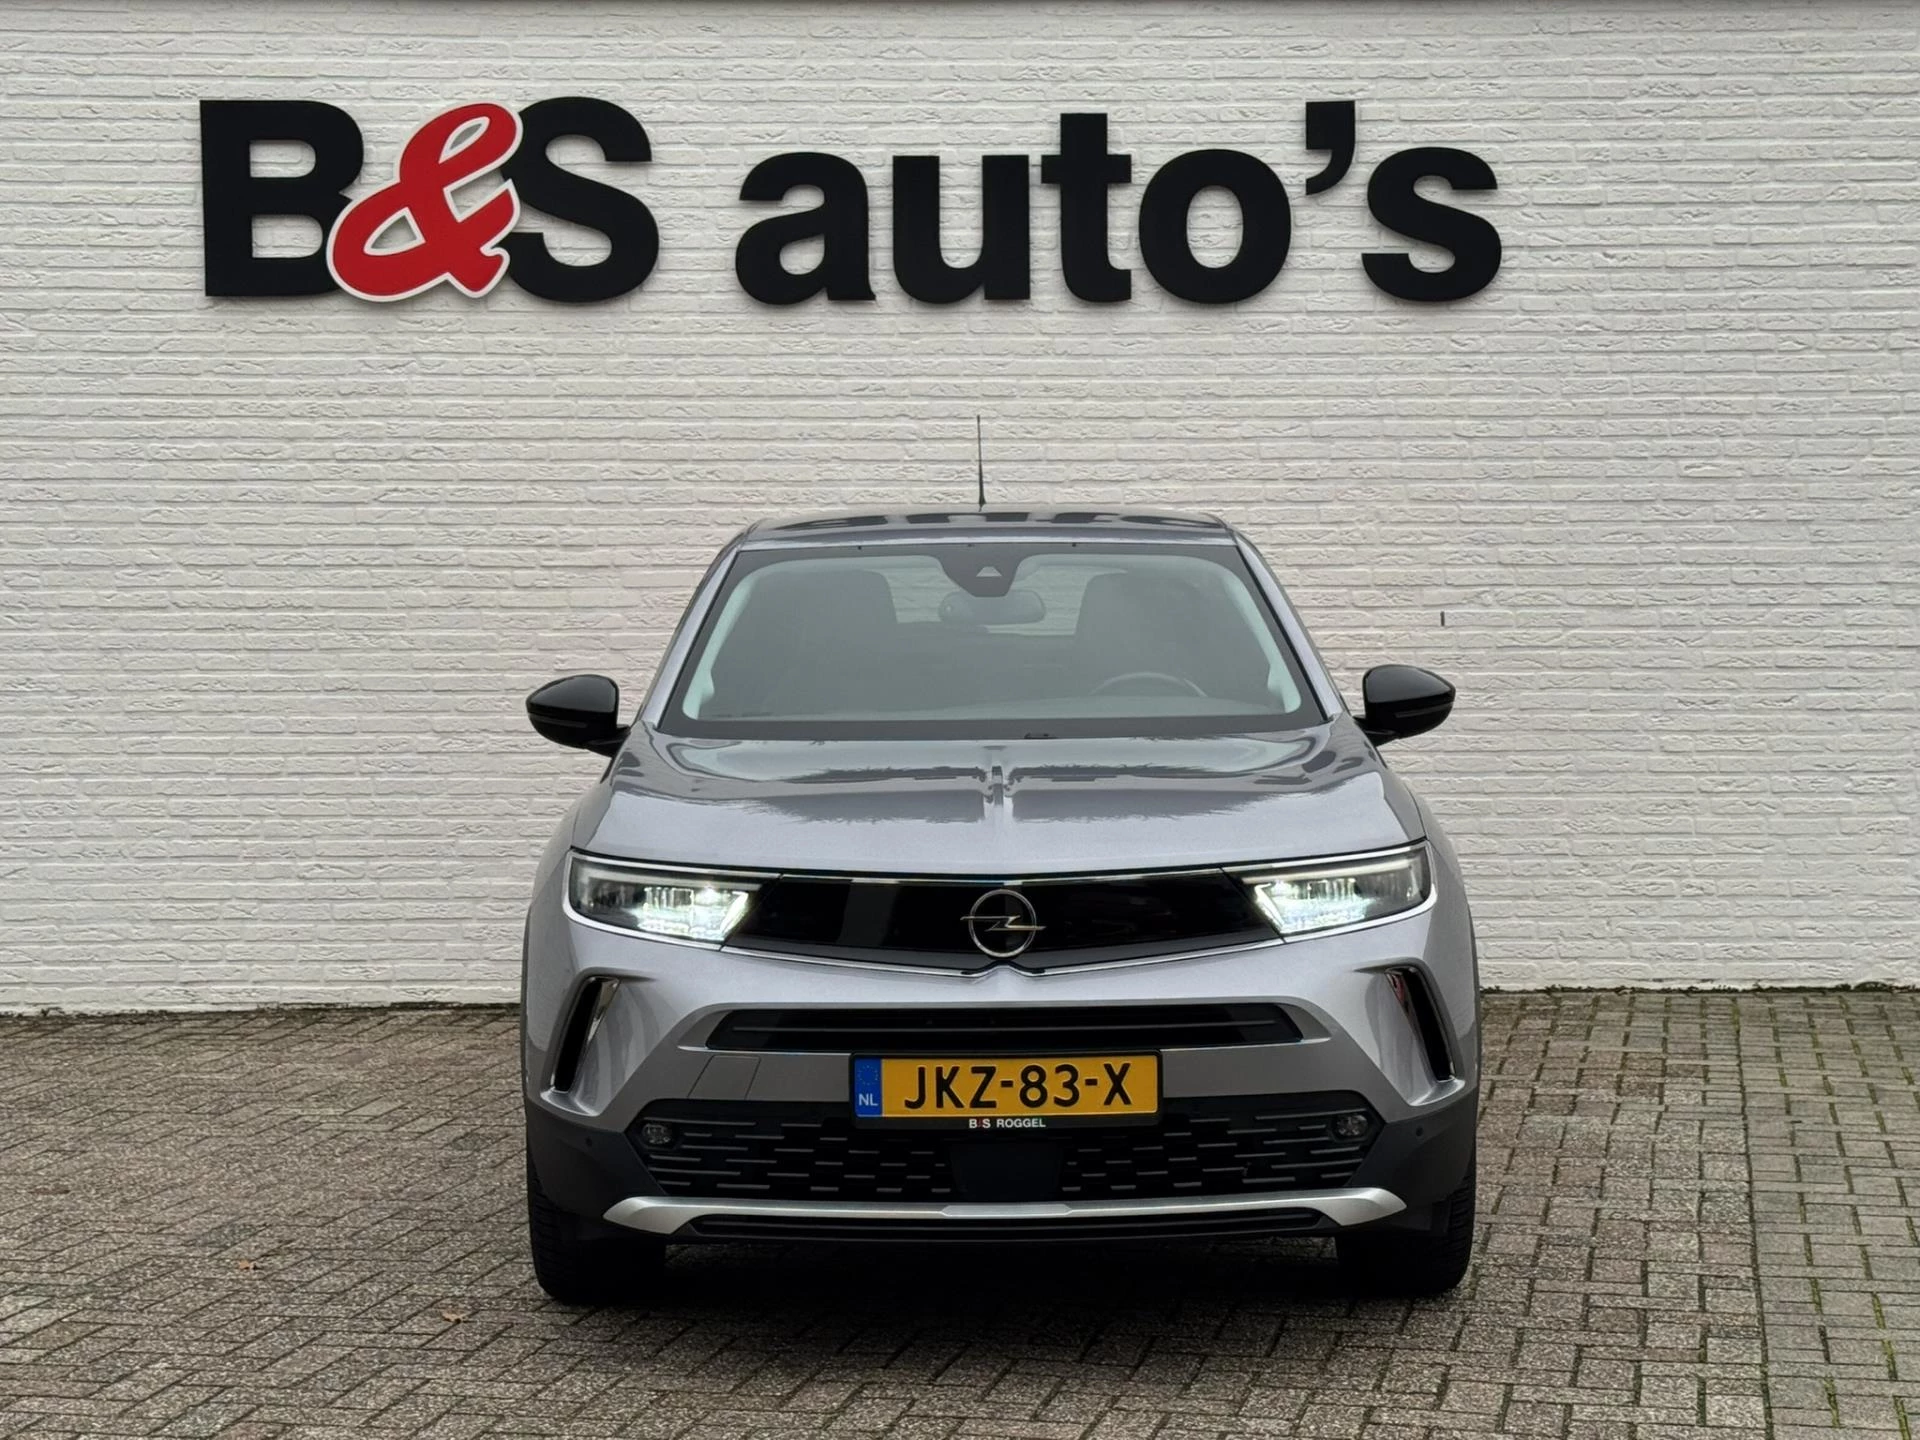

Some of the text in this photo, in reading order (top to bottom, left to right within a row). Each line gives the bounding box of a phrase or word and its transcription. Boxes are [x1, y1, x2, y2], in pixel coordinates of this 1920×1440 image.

[200, 97, 1502, 304] B&S auto's
[858, 1093, 878, 1106] NL
[904, 1062, 1132, 1110] JKZ-83-X
[996, 1117, 1046, 1128] ROGGEL
